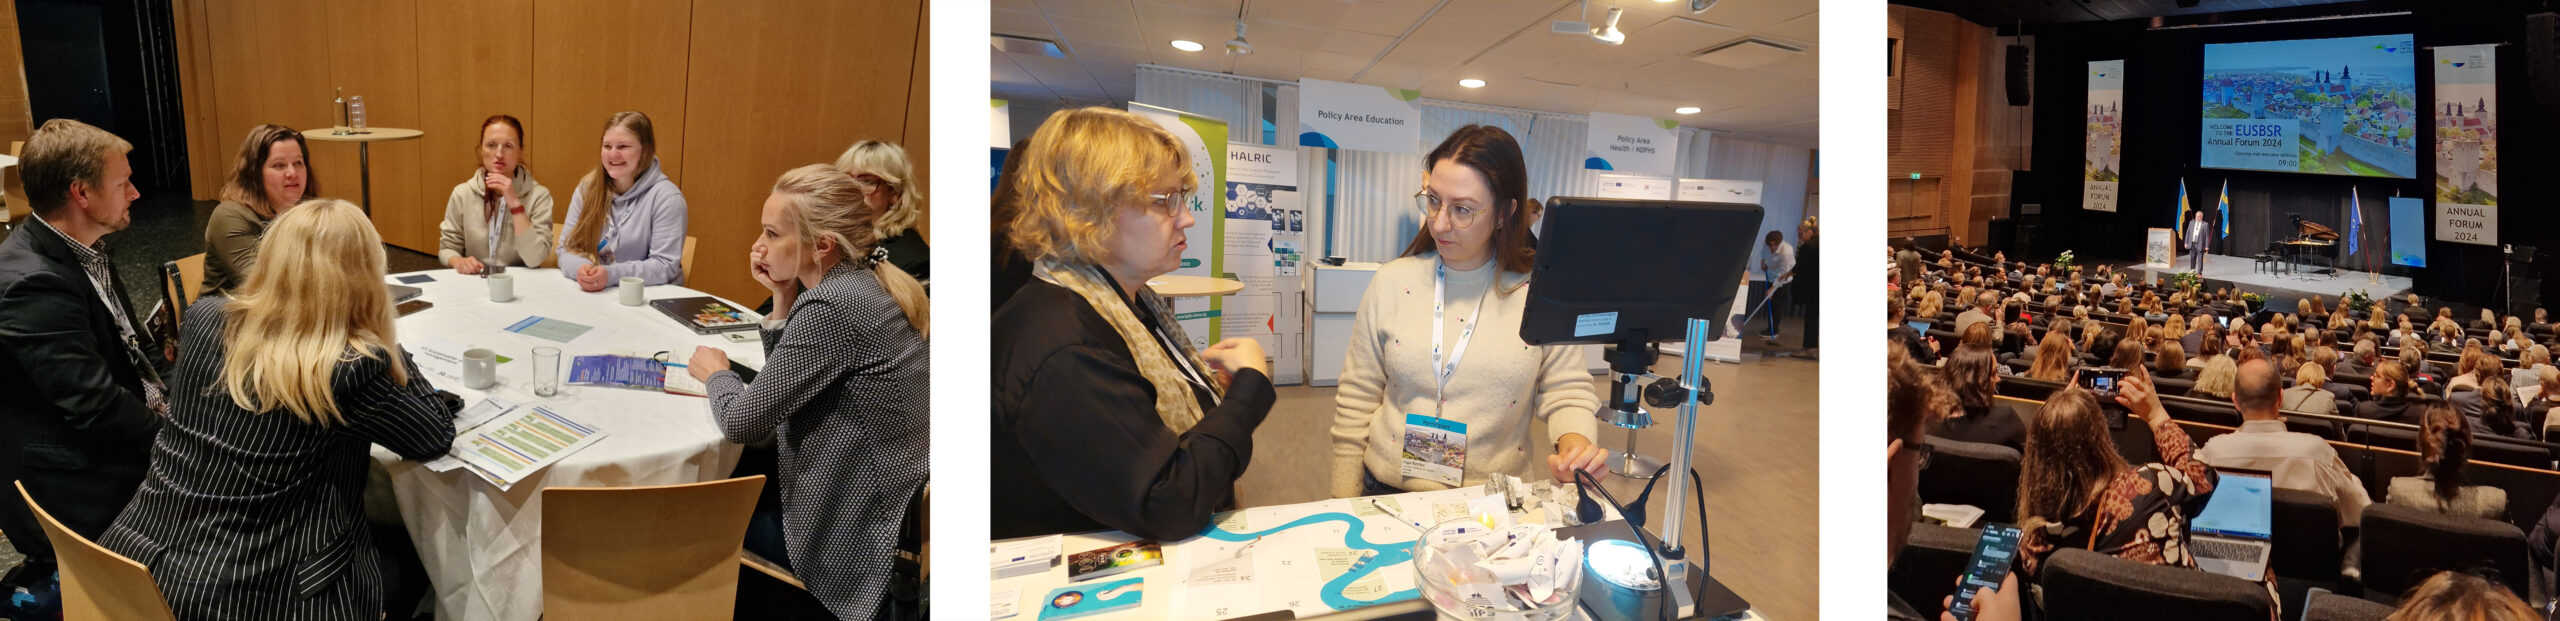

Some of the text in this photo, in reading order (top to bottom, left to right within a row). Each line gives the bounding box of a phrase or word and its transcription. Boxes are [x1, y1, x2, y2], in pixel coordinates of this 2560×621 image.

[1317, 109, 1404, 126] Policy Area Education
[2234, 124, 2282, 137] EUSBSR
[2207, 137, 2282, 148] Annual Forum 2024
[1230, 151, 1272, 164] HALRIC
[2447, 207, 2486, 218] ANNUAL
[2448, 219, 2484, 230] FORUM
[2454, 231, 2478, 241] 2024
